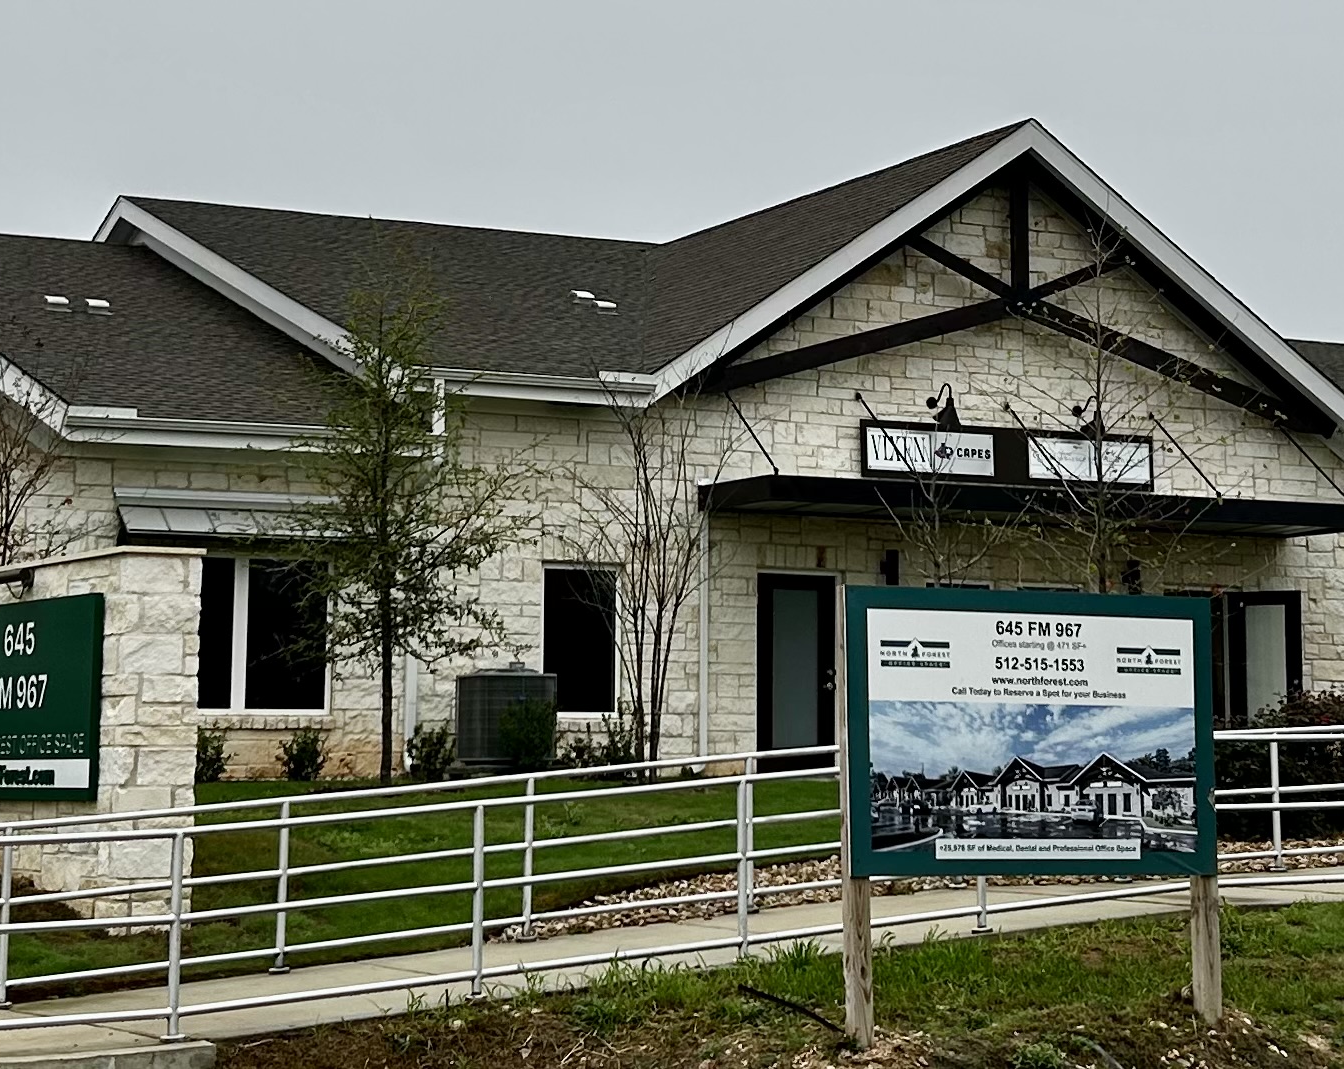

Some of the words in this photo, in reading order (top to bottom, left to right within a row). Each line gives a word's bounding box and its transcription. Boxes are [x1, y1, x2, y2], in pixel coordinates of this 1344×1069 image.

[957, 448, 991, 460] CAPES
[995, 620, 1023, 636] 645
[1028, 622, 1051, 636] FM
[1055, 623, 1082, 638] 967
[3, 622, 35, 656] 645
[992, 639, 1017, 648] Offices
[1019, 640, 1045, 650] starting
[995, 656, 1085, 672] 512-515-1553
[992, 676, 1089, 686] www.northforest.com
[16, 674, 47, 709] 967
[951, 686, 967, 695] Call
[969, 687, 991, 697] Today
[993, 688, 1001, 696] to
[1003, 688, 1034, 697] Reserve
[1043, 689, 1059, 698] Spot
[1061, 689, 1072, 698] for
[1073, 691, 1091, 700] your
[1093, 690, 1127, 699] Business
